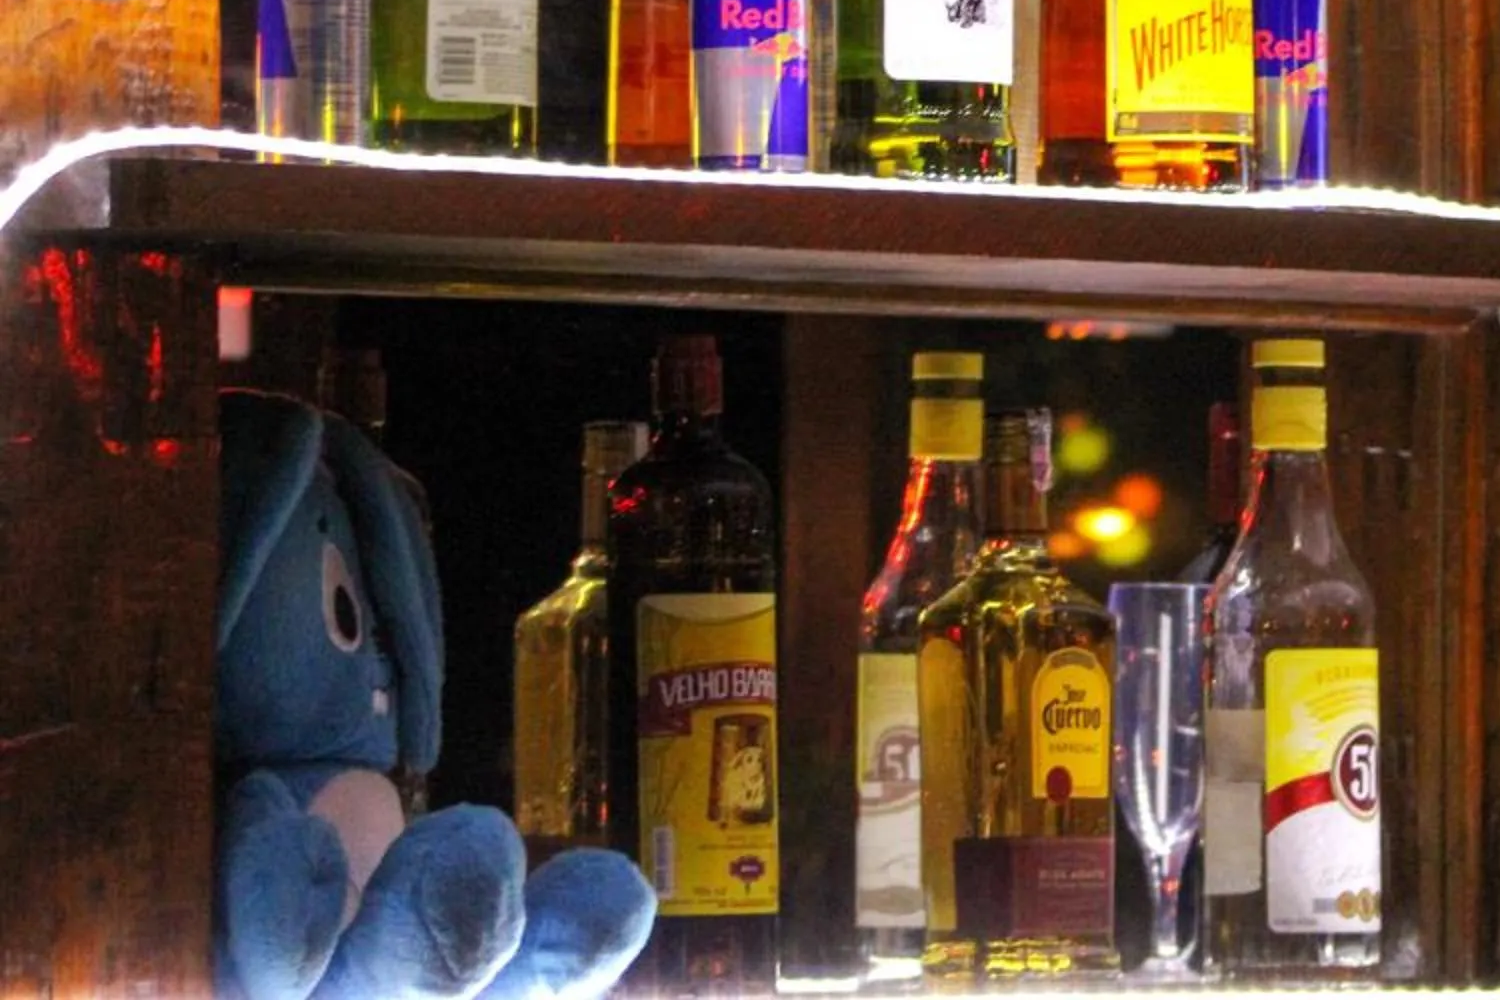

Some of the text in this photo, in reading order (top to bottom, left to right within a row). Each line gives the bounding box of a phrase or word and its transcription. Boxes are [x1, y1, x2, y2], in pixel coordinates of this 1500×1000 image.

[1130, 10, 1208, 92] WHITE
[659, 668, 728, 707] VELHO
[1042, 697, 1102, 736] Cuervo
